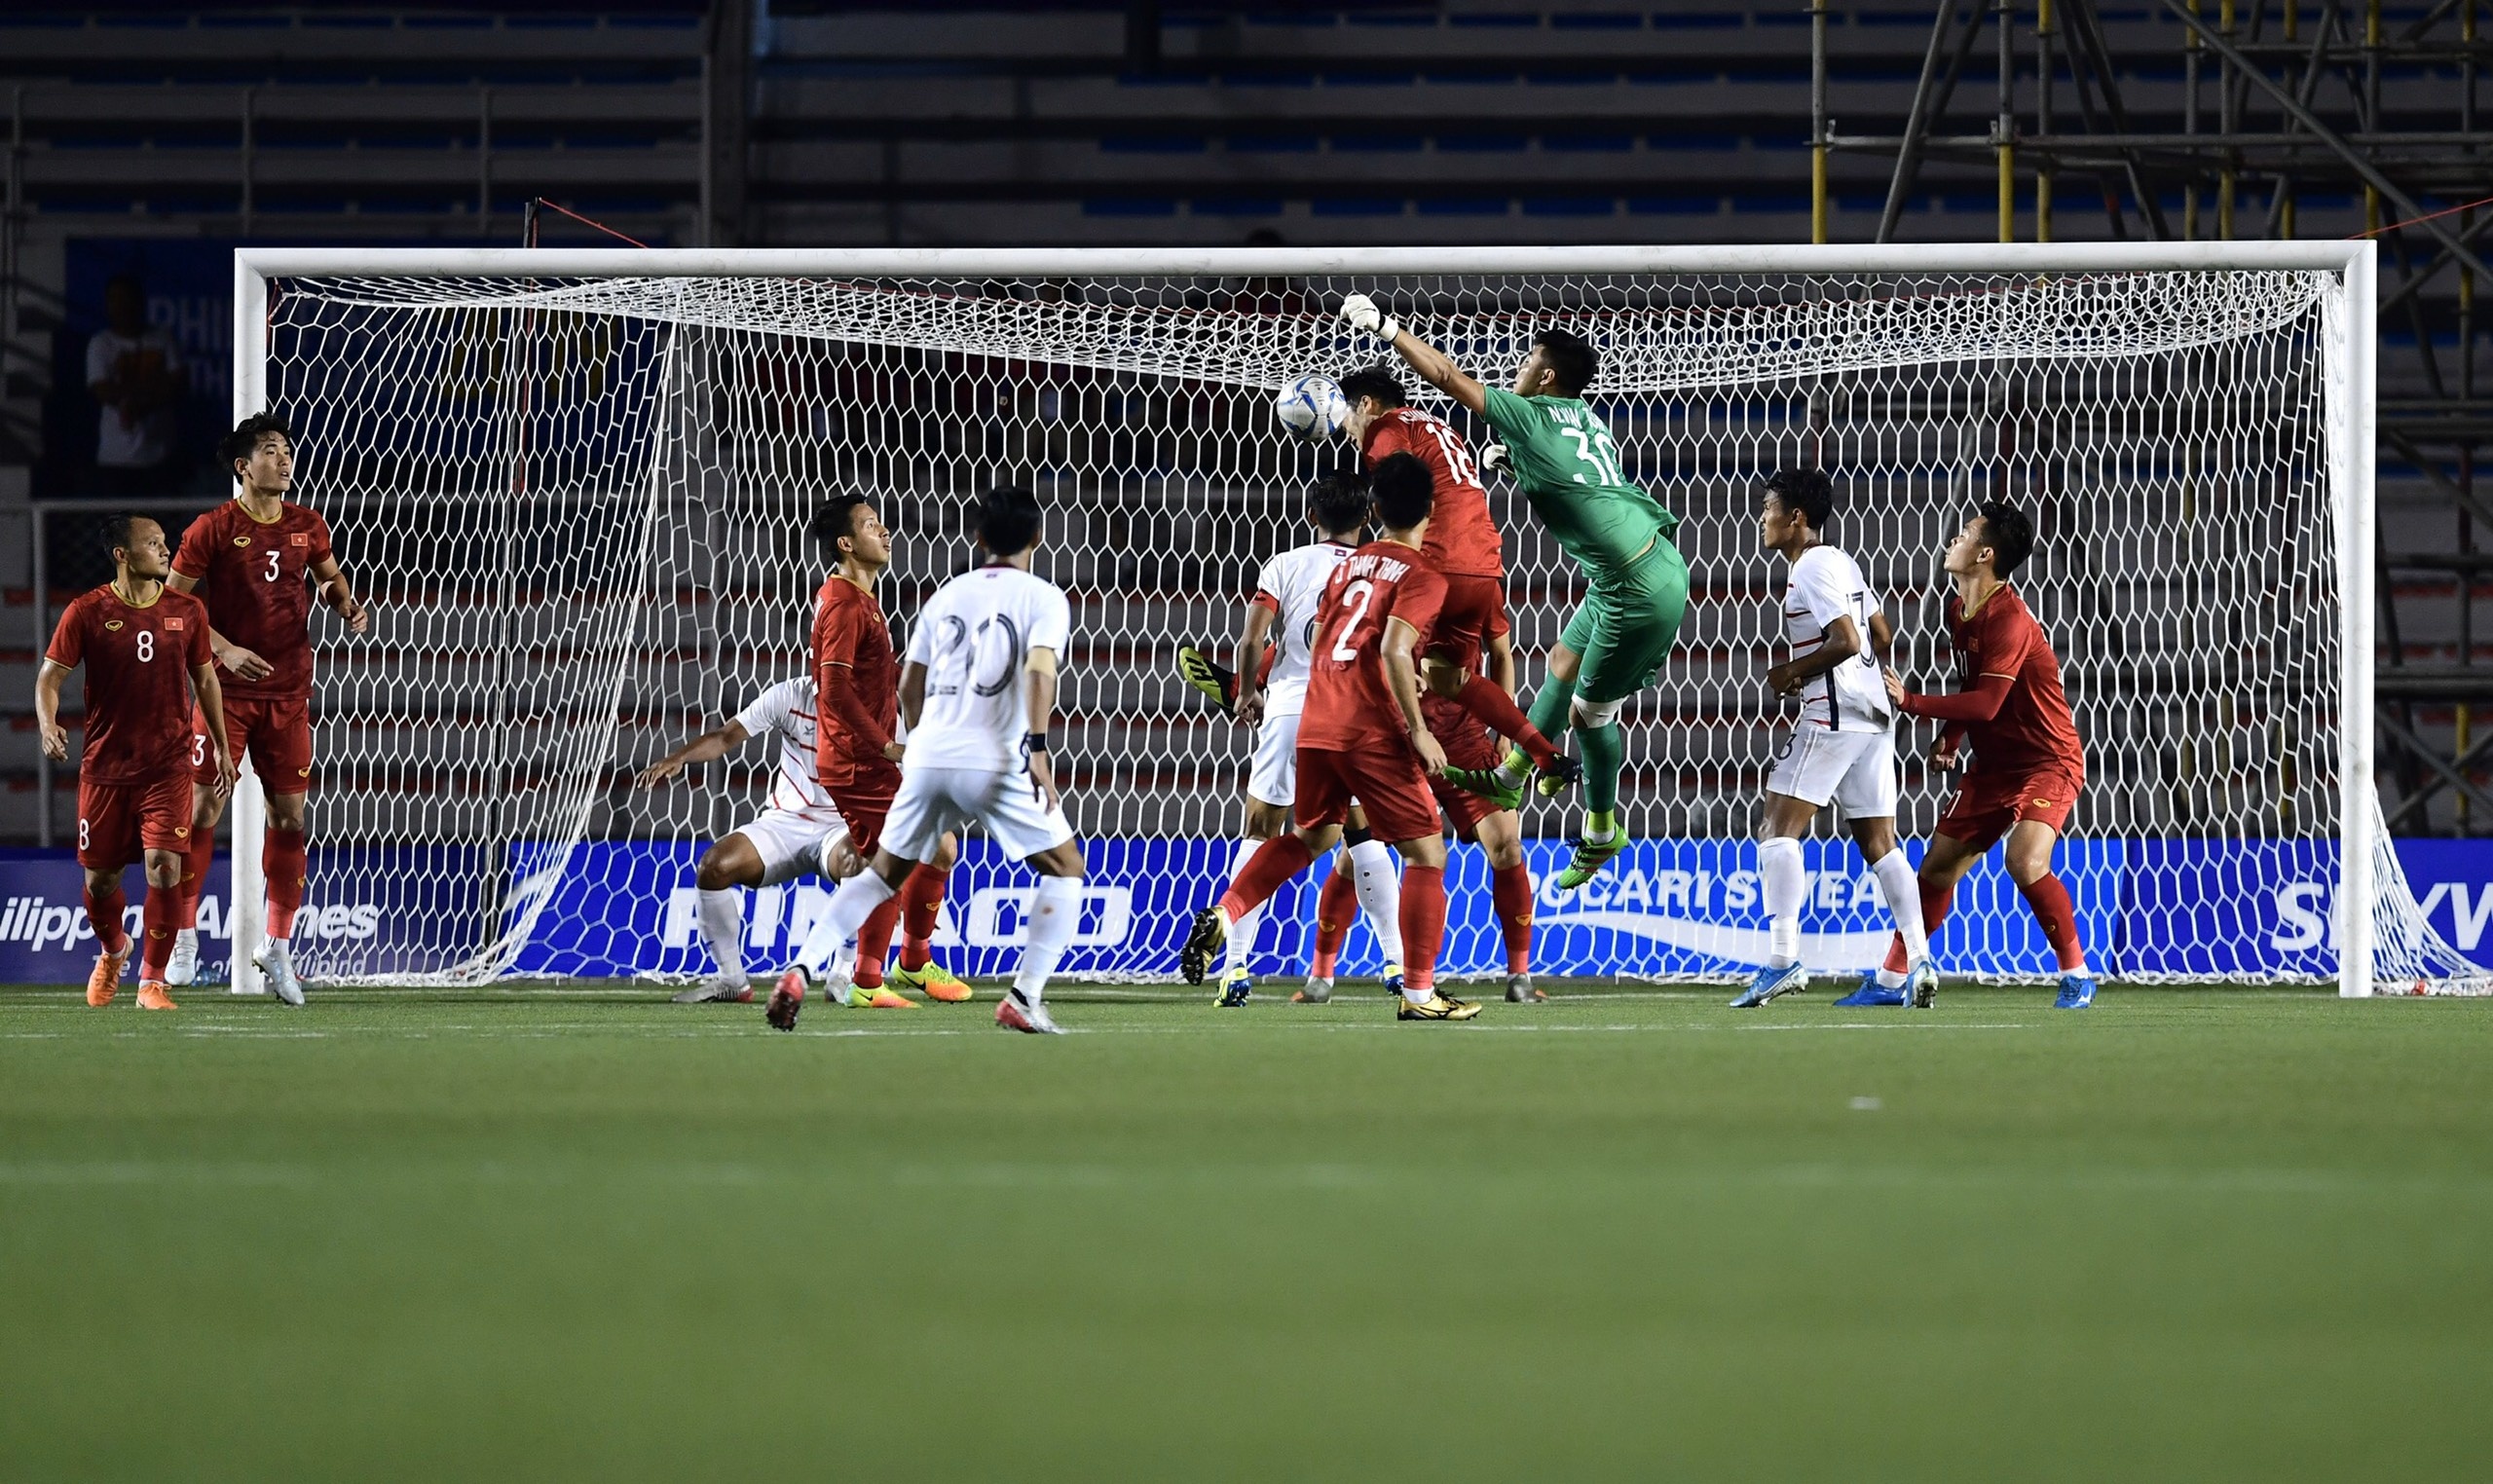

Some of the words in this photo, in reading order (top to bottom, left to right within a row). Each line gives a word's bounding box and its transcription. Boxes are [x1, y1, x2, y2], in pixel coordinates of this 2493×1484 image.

[263, 549, 279, 582] 3
[1331, 579, 1374, 661] 2
[136, 630, 154, 662] 8
[925, 613, 1020, 698] 20
[192, 734, 205, 766] 3
[78, 818, 90, 851] 8
